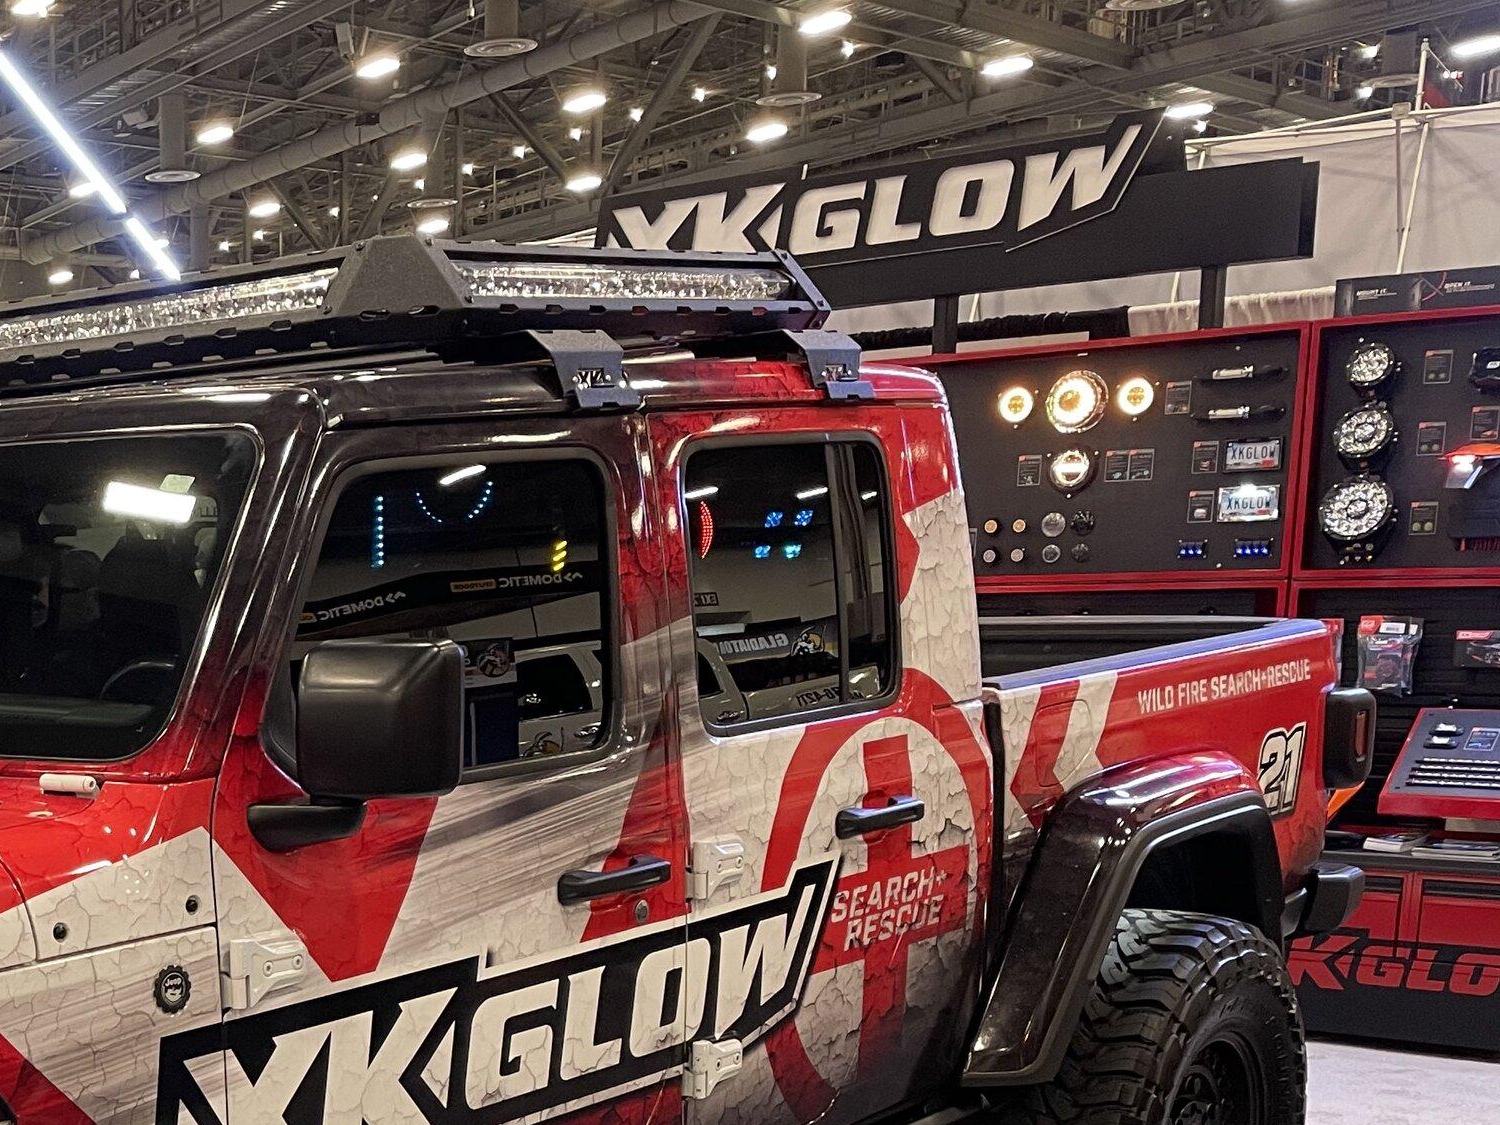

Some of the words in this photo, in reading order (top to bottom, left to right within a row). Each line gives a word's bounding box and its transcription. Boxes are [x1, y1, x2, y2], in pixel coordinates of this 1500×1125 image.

[611, 124, 1142, 255] XKGLOW
[1230, 445, 1276, 460] XKGLOW
[1226, 496, 1272, 510] XKGLOW
[1137, 685, 1174, 713] WILD
[1178, 679, 1209, 707] FIRE
[1257, 722, 1306, 815] 21
[844, 895, 945, 951] RESCUE
[1286, 934, 1500, 997] KGLO
